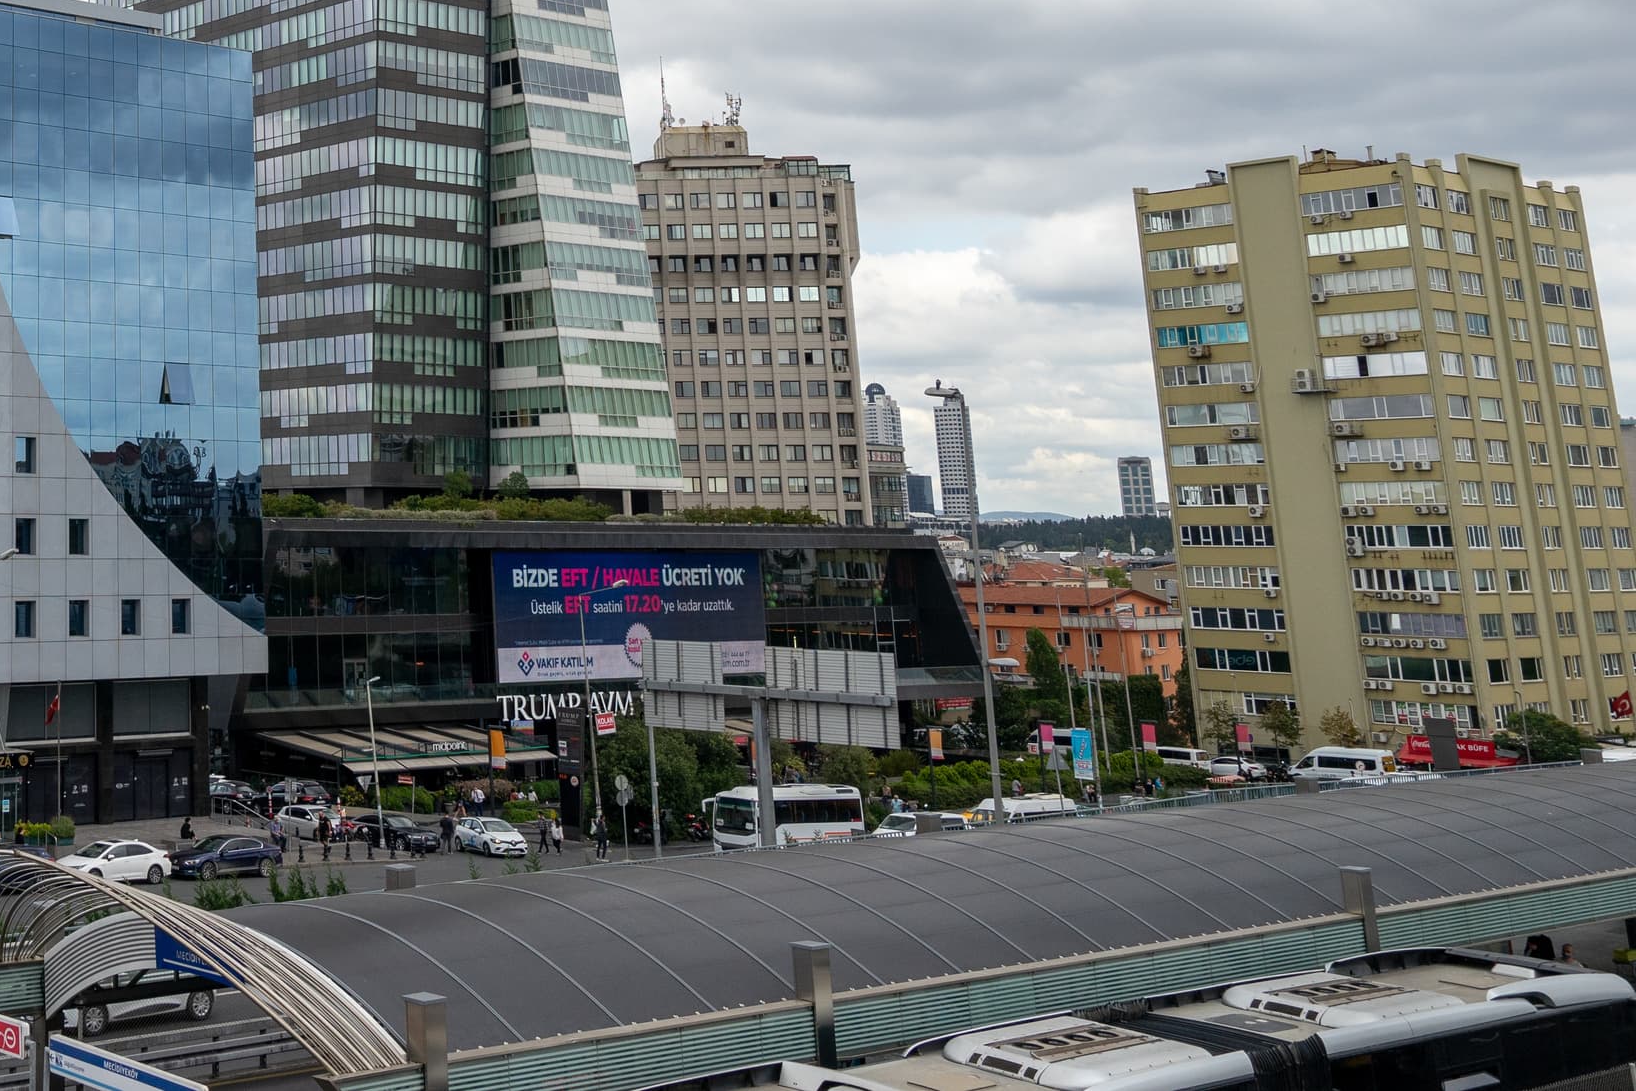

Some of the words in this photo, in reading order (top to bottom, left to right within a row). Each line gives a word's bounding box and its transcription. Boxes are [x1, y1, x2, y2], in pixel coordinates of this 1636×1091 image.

[512, 564, 558, 588] BİZDE
[561, 568, 589, 587] EFT
[591, 566, 600, 589] /
[602, 568, 660, 587] HAVALE
[661, 564, 712, 587] ÜCRETİ
[530, 599, 563, 615] Üstelik
[565, 595, 591, 615] EFT
[593, 600, 623, 614] saatini
[676, 599, 701, 612] kadar
[535, 657, 559, 669] VAKIF
[561, 656, 594, 668] KATILM
[496, 692, 581, 721] TRUMP
[586, 690, 634, 717] AVM
[432, 741, 466, 752] midpoint
[1467, 743, 1489, 753] BÜFE
[103, 1059, 139, 1079] MECİDİYEKÖY
